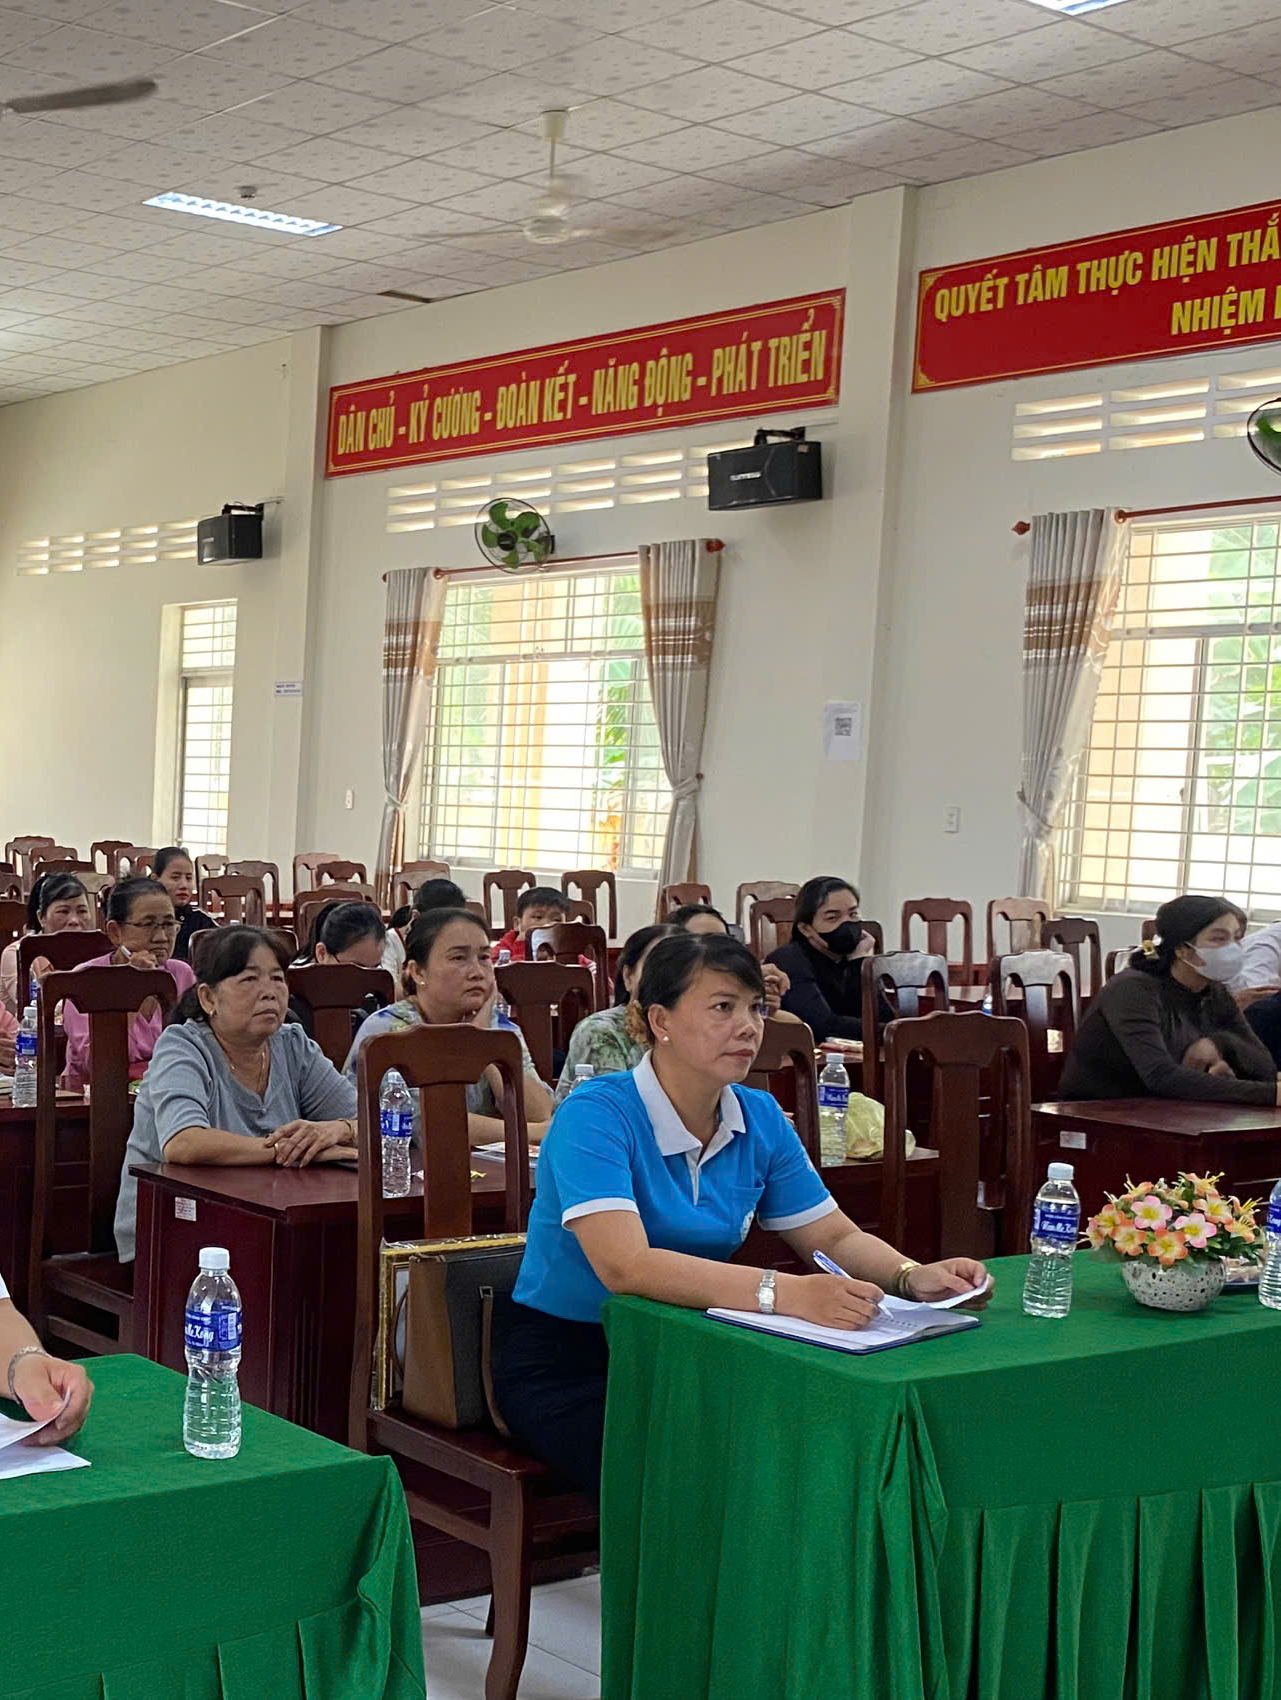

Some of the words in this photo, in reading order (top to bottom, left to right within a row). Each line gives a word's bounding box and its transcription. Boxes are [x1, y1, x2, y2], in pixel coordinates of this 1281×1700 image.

[934, 269, 1009, 322] QUYẾT
[1015, 265, 1069, 305] TÂM
[1076, 250, 1144, 296] THỰC
[1151, 235, 1218, 283] HIỆN
[1171, 286, 1266, 336] NHIỆM
[337, 404, 367, 455] DÂN
[368, 390, 396, 451] CHỦ
[408, 384, 429, 444] KỶ
[432, 386, 481, 441] CƯƠNG
[496, 371, 540, 431] ĐOÀN
[542, 360, 577, 423] KẾT
[591, 358, 640, 416] NĂNG
[644, 346, 694, 418] ĐỘNG
[710, 331, 764, 397] PHÁT
[768, 308, 827, 388] TRIỂN
